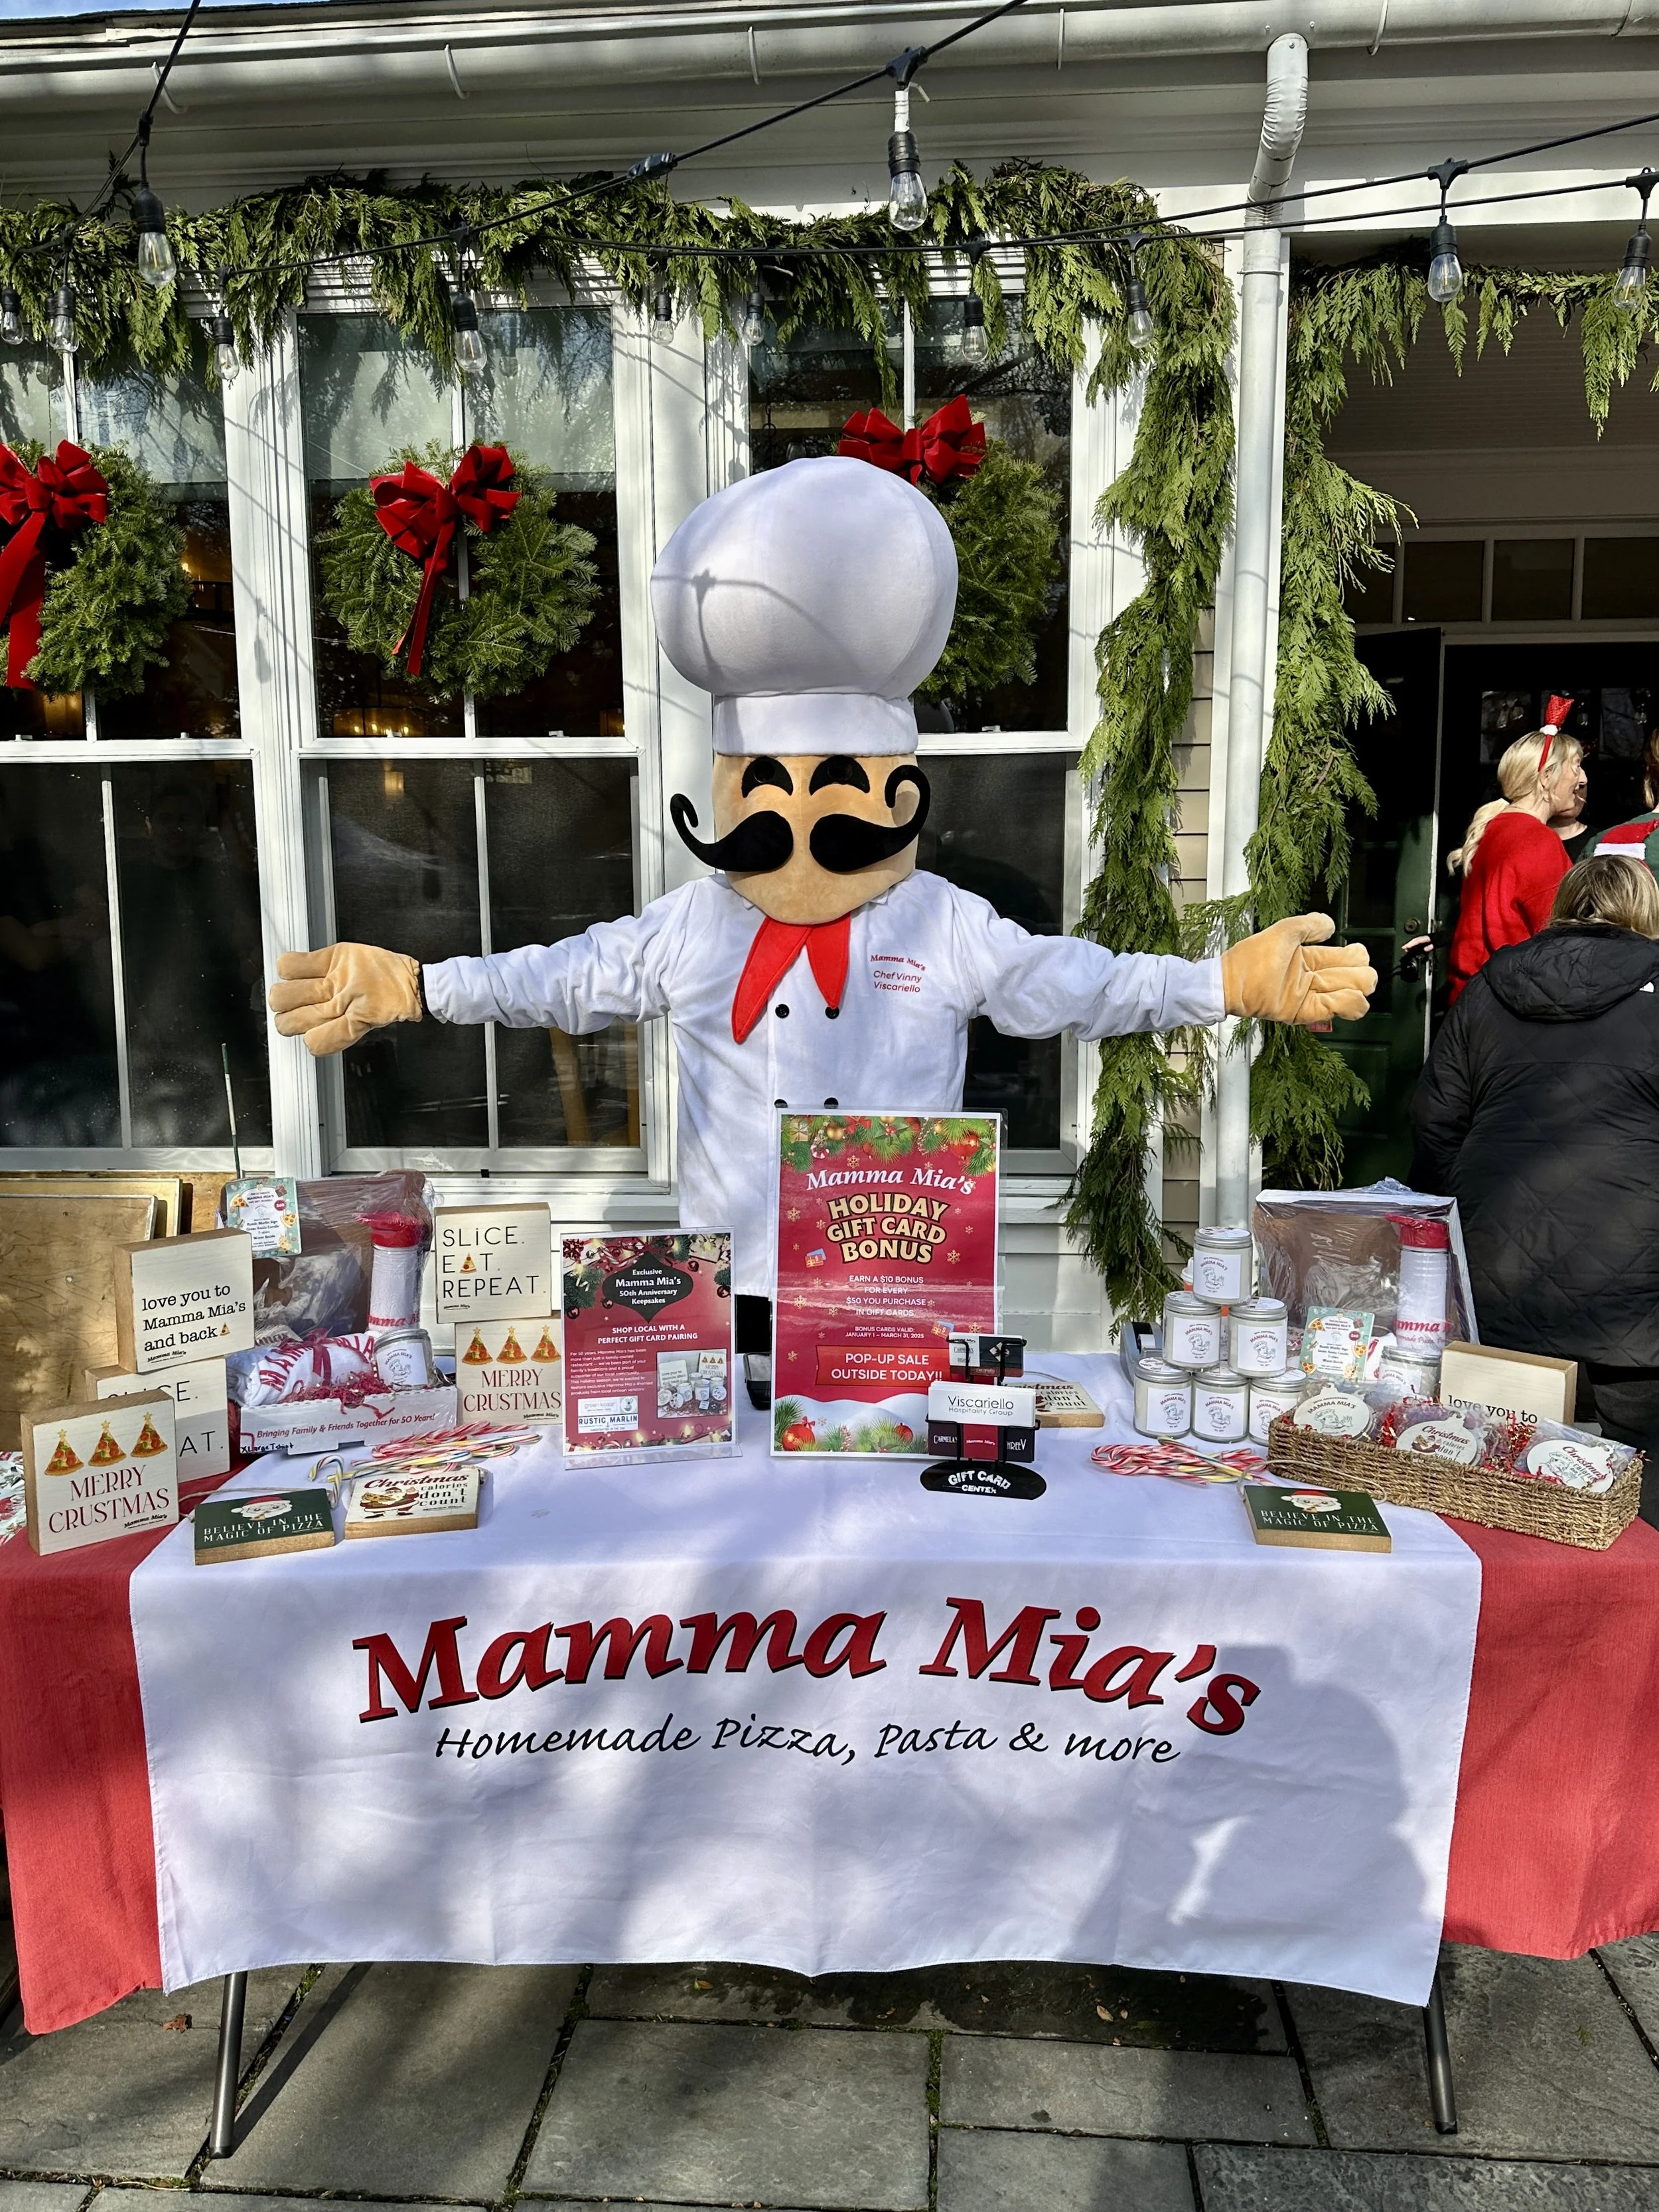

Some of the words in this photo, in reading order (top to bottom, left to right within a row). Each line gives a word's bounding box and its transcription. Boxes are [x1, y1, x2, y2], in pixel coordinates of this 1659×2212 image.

[906, 958, 926, 971] Mia's
[873, 970, 896, 980] Chef
[897, 973, 922, 983] Vinny
[874, 982, 920, 993] Viscariello
[806, 1169, 903, 1191] Mamma
[910, 1167, 974, 1195] Mia's
[827, 1192, 950, 1222] HOLIDAY
[826, 1218, 877, 1242] GIFT
[881, 1217, 947, 1244] CARD
[840, 1238, 933, 1264] BONUS
[443, 1275, 547, 1298] REPEAT.
[615, 1278, 655, 1288] Mamma
[656, 1276, 682, 1286] Mia's
[880, 1275, 893, 1284] $10
[142, 1295, 177, 1311] love
[180, 1290, 211, 1307] you
[214, 1285, 230, 1297] to
[143, 1310, 204, 1331] Mamma
[208, 1301, 246, 1318] Mia's
[144, 1334, 176, 1352] and
[179, 1326, 218, 1344] back
[147, 1352, 171, 1362] Mamma
[845, 1353, 895, 1364] POP-UP
[897, 1354, 930, 1366] SALE
[481, 1368, 543, 1388] MERRY
[831, 1368, 887, 1380] OUTSIDE
[890, 1369, 943, 1382] TODAY!!
[463, 1391, 561, 1412] CRUSTMAS
[948, 1395, 1014, 1410] Viscariello
[1307, 1400, 1336, 1414] MAMMA
[1337, 1400, 1356, 1409] MIA'S
[1448, 1395, 1482, 1411] love
[1521, 1410, 1538, 1424] to
[948, 1407, 987, 1416] Hospitality
[989, 1408, 1013, 1417] Group
[257, 1430, 289, 1439] Bringing
[292, 1426, 317, 1435] Family
[328, 1422, 354, 1431] Friends
[356, 1420, 388, 1429] Together
[389, 1417, 400, 1426] for
[401, 1416, 412, 1424] 50
[414, 1413, 436, 1422] Years!
[1422, 1426, 1470, 1445] Christmas
[1439, 1445, 1461, 1457] don't
[70, 1465, 146, 1501] MERRY
[364, 1475, 470, 1489] Christmas
[421, 1482, 469, 1491] calories
[948, 1470, 975, 1485] GIFT
[977, 1471, 1011, 1489] CARD
[419, 1497, 467, 1507] count
[420, 1488, 468, 1499] don't
[48, 1488, 170, 1533] CRUSTMAS
[1261, 1510, 1320, 1520] BELIEVE
[1347, 1515, 1376, 1524] THE
[123, 1515, 150, 1528] Mamma
[204, 1520, 265, 1534] BELIEVE
[273, 1517, 287, 1526] IN
[294, 1512, 323, 1522] THE
[204, 1530, 250, 1542] MAGIC
[257, 1526, 275, 1536] OF
[282, 1520, 324, 1530] PIZZA
[1263, 1517, 1307, 1526] MAGIC
[1338, 1522, 1379, 1531] PIZZA
[352, 1609, 888, 1724] Mamma
[919, 1596, 1261, 1735] Mia's
[435, 1713, 701, 1759] Homemade
[711, 1713, 855, 1765] Pizza,
[874, 1719, 998, 1759] Pasta
[1009, 1722, 1048, 1752] &
[1064, 1732, 1181, 1763] more
